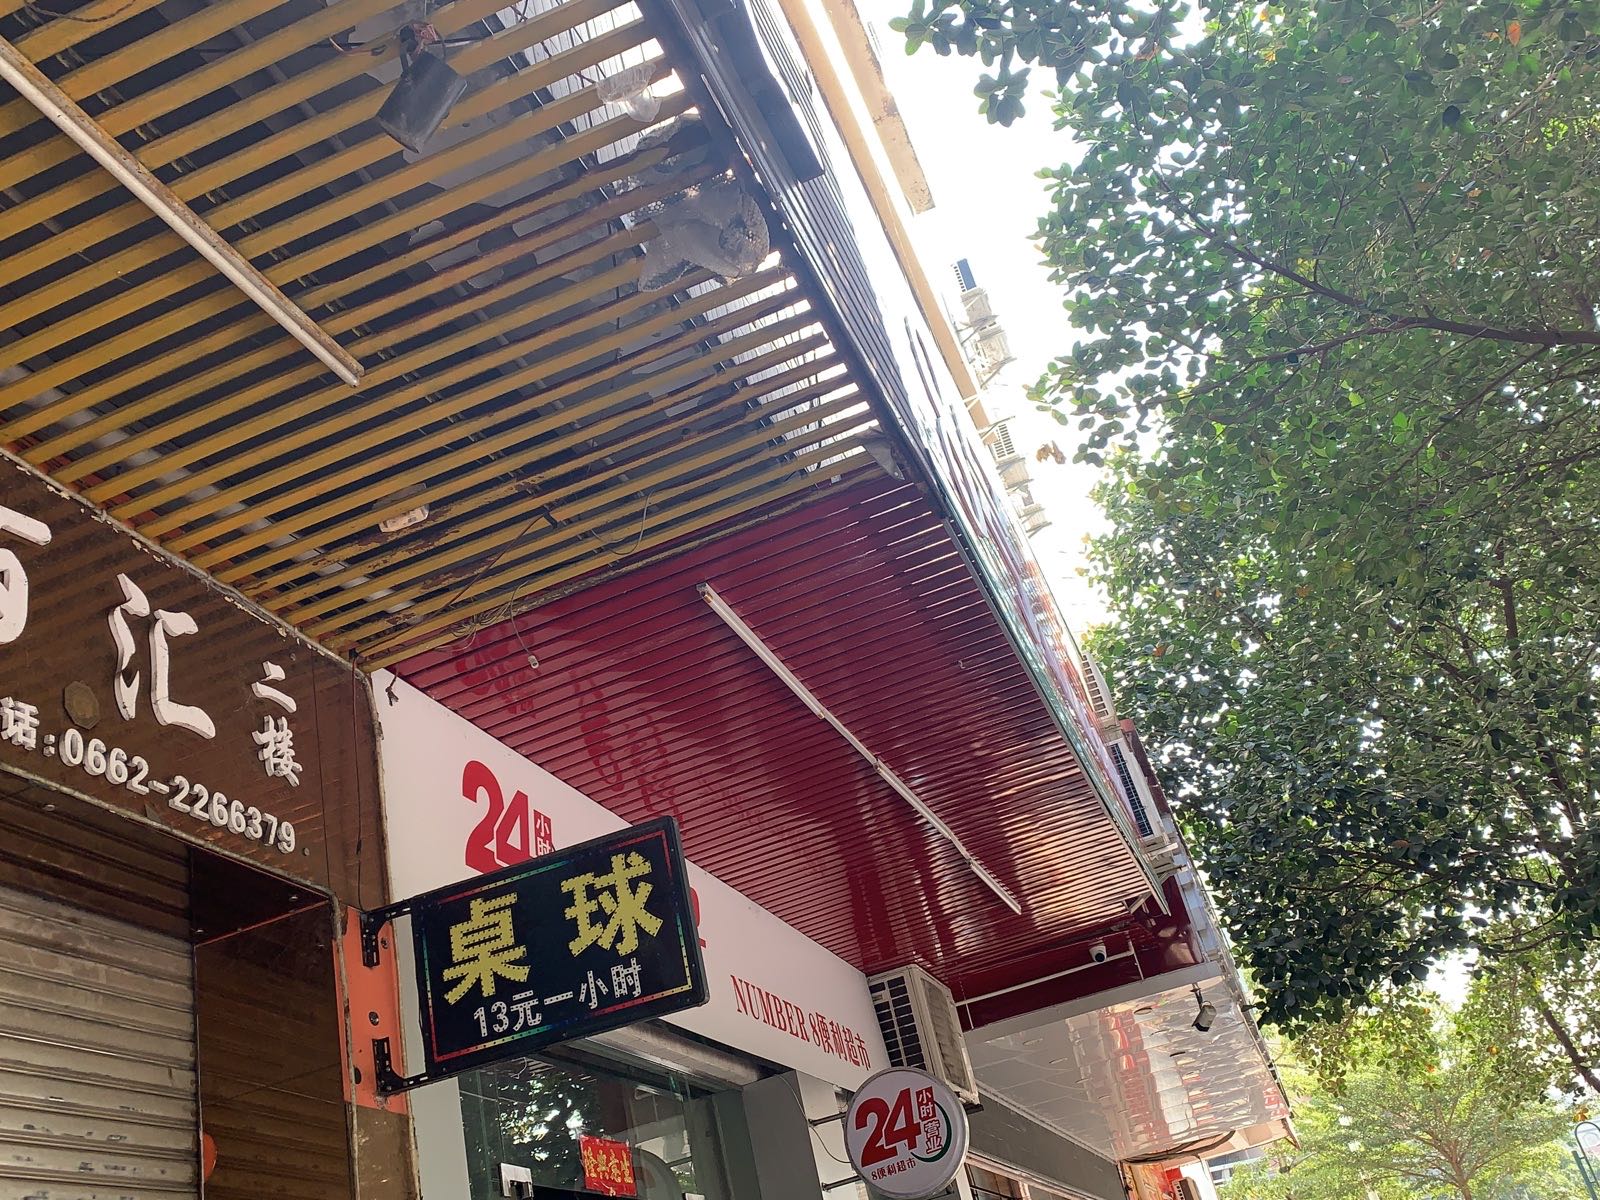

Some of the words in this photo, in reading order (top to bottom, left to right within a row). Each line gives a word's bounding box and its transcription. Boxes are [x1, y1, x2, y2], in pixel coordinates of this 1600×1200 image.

[251, 660, 303, 787] 二楼
[461, 760, 531, 874] 24
[443, 850, 664, 1005] 桌球
[473, 957, 643, 1037] 13元一小时
[730, 974, 810, 1043] NUMBER
[808, 1011, 872, 1071] 8便利超市
[855, 1087, 922, 1168] 24
[871, 1157, 917, 1181] 8便利超市
